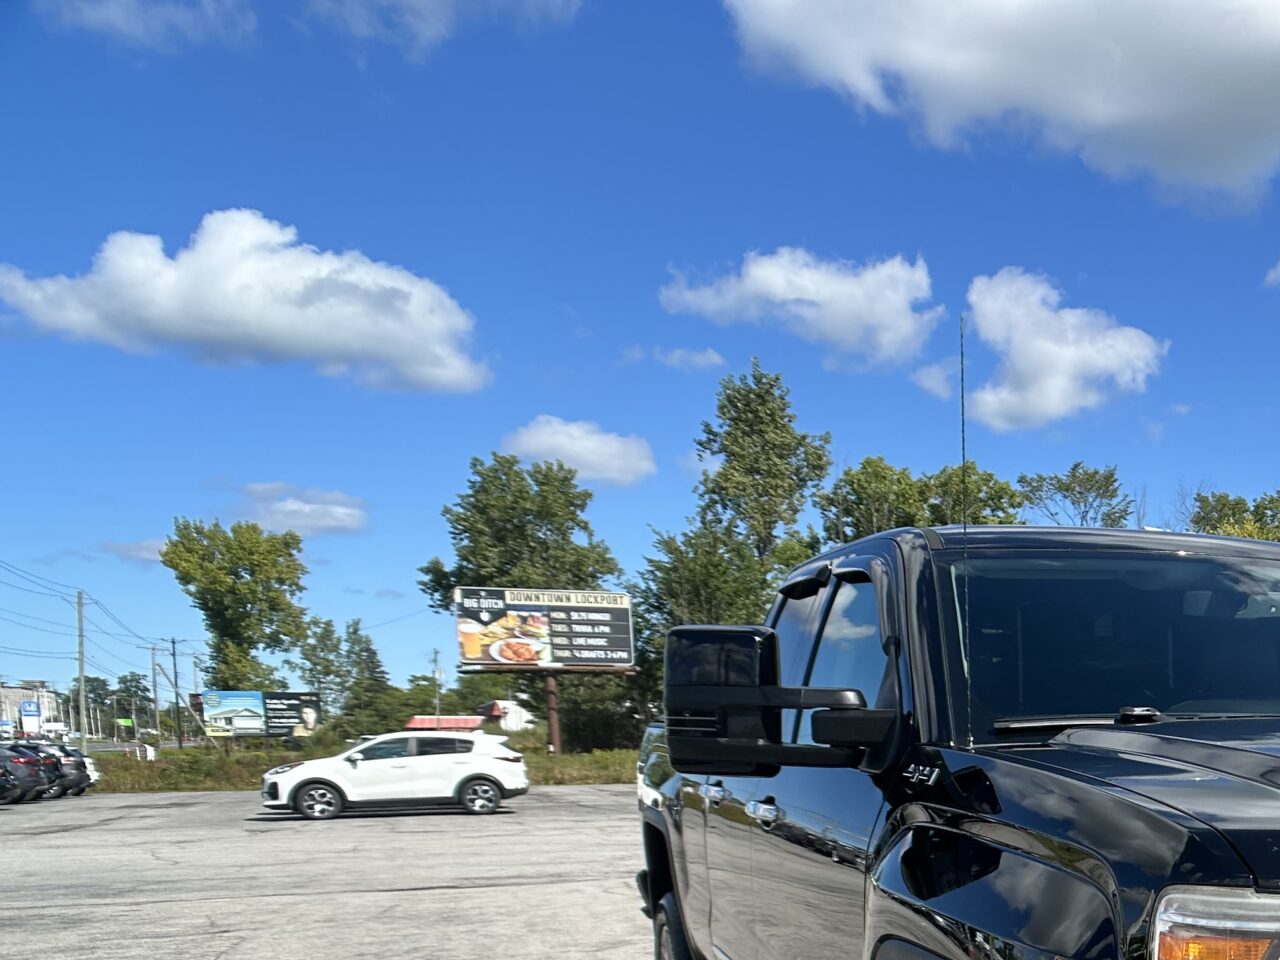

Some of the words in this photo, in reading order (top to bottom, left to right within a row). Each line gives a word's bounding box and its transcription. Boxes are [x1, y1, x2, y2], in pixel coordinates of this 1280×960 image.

[463, 598, 478, 609] BIG
[480, 599, 504, 609] DITCH
[509, 591, 572, 603] DOWNTOWN
[575, 594, 625, 606] LOCKPORT
